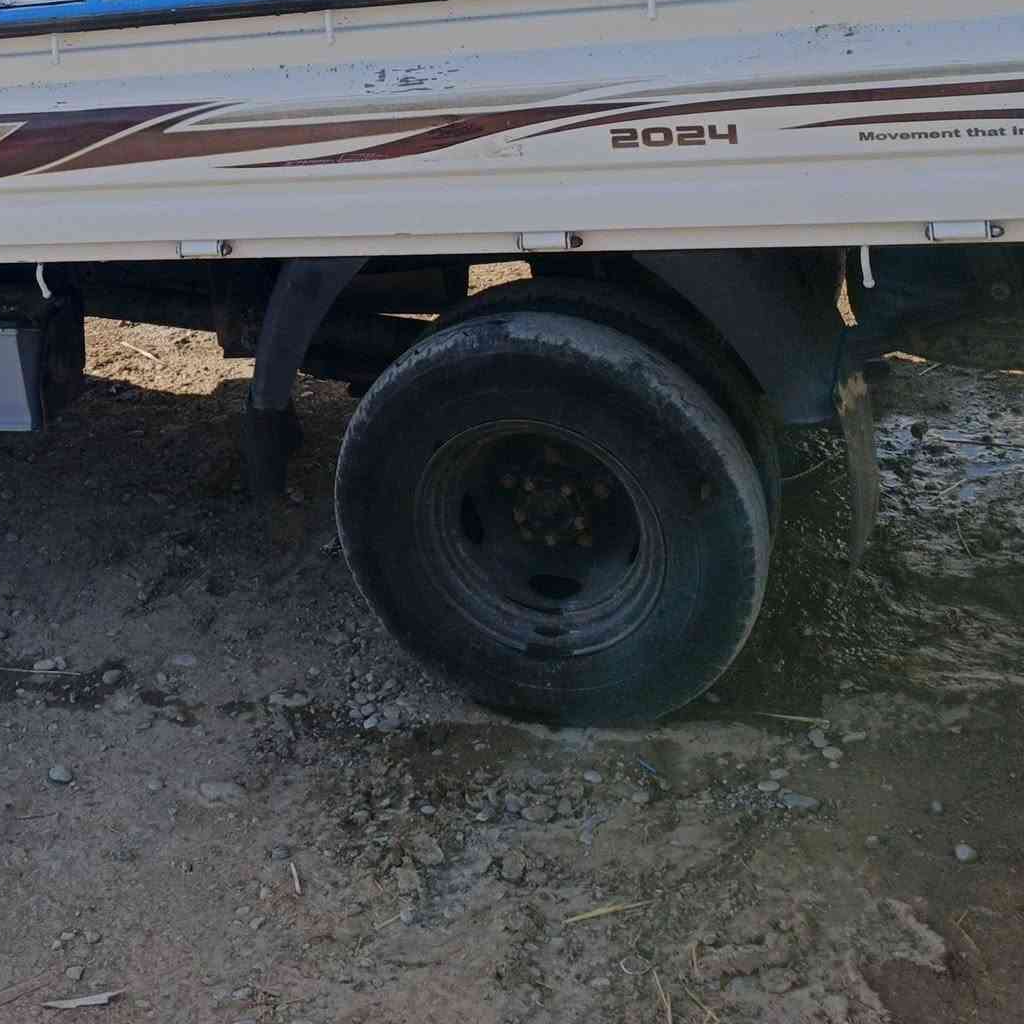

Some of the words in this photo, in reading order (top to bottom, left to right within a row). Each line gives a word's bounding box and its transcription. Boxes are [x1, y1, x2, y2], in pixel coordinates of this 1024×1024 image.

[609, 124, 738, 149] 2024
[859, 128, 961, 141] Movement
[966, 126, 1007, 137] that
